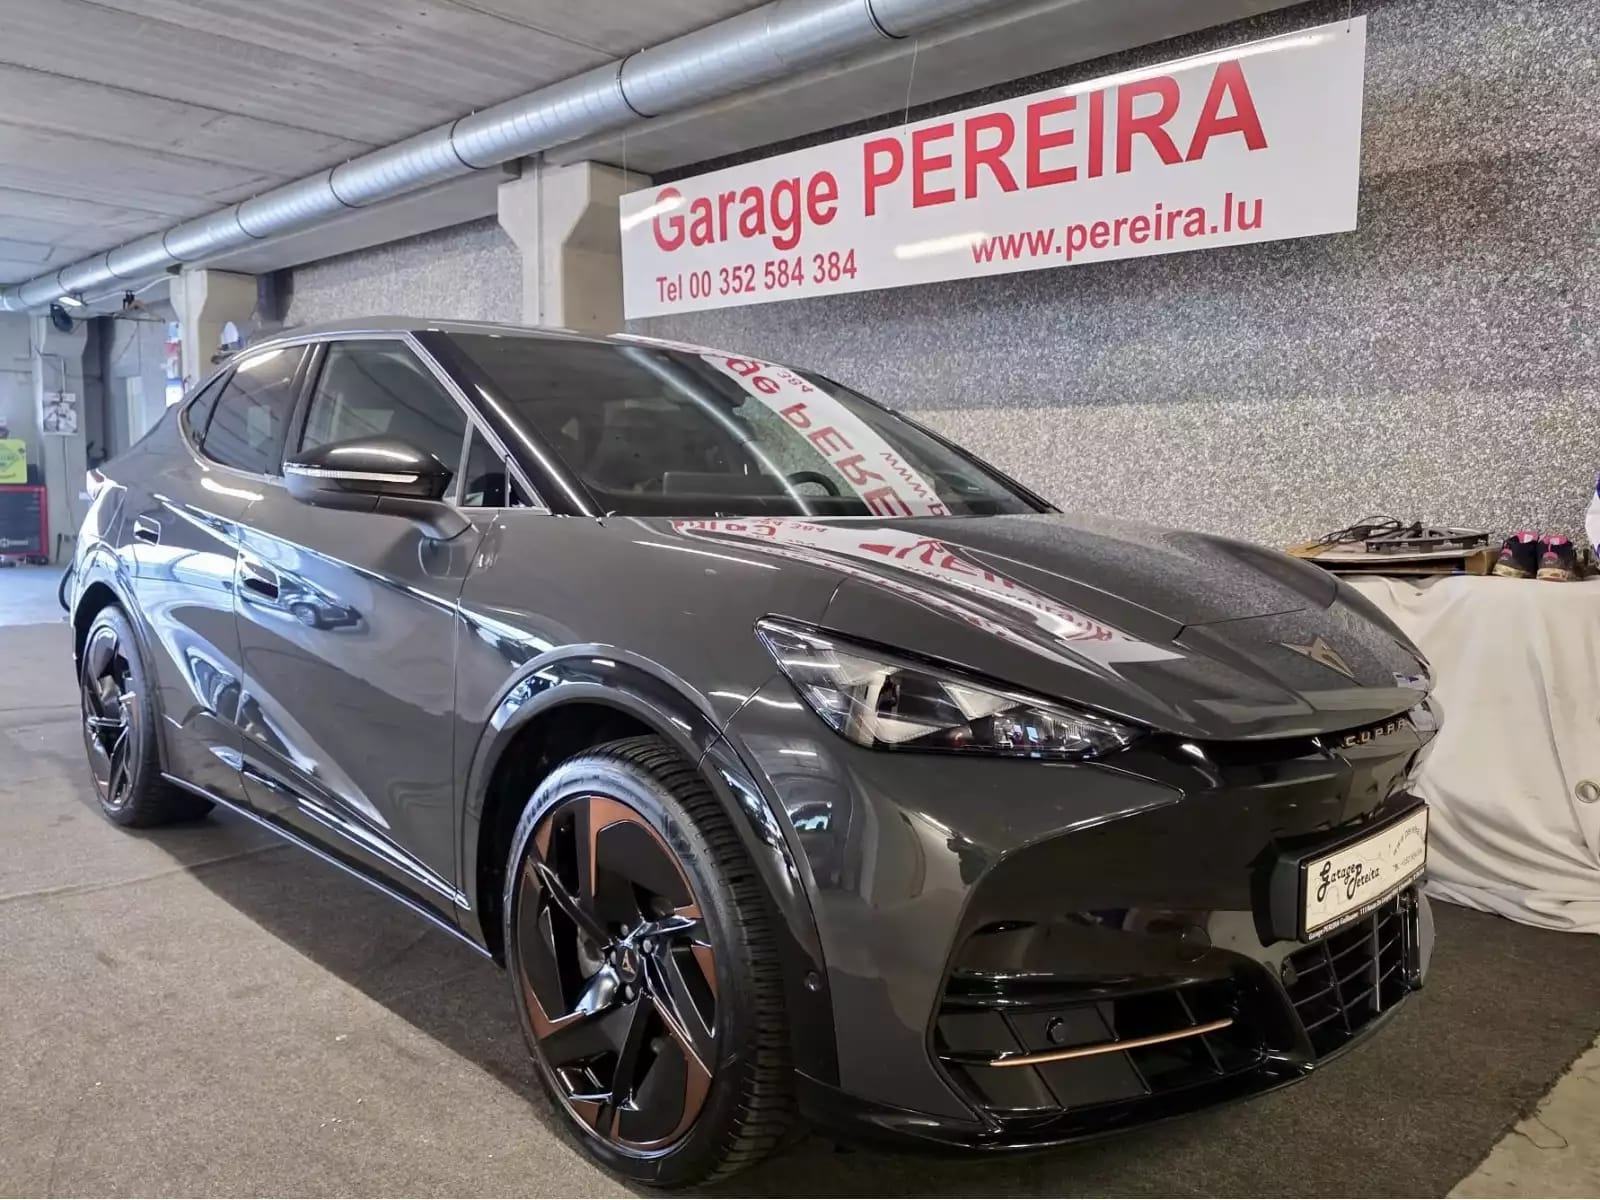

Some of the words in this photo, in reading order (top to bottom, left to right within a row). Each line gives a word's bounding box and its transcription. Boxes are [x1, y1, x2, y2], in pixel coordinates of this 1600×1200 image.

[652, 169, 840, 253] Garage
[863, 59, 1268, 218] PEREIRA
[971, 192, 1264, 264] www.pereira.lu
[656, 273, 682, 302] Tel
[689, 270, 712, 299] 00
[719, 263, 756, 295] 352
[764, 256, 805, 291] 584
[813, 248, 858, 285] 384
[1345, 719, 1405, 748] CUPRA
[1317, 860, 1355, 902] Garage
[1346, 862, 1380, 900] Pereira
